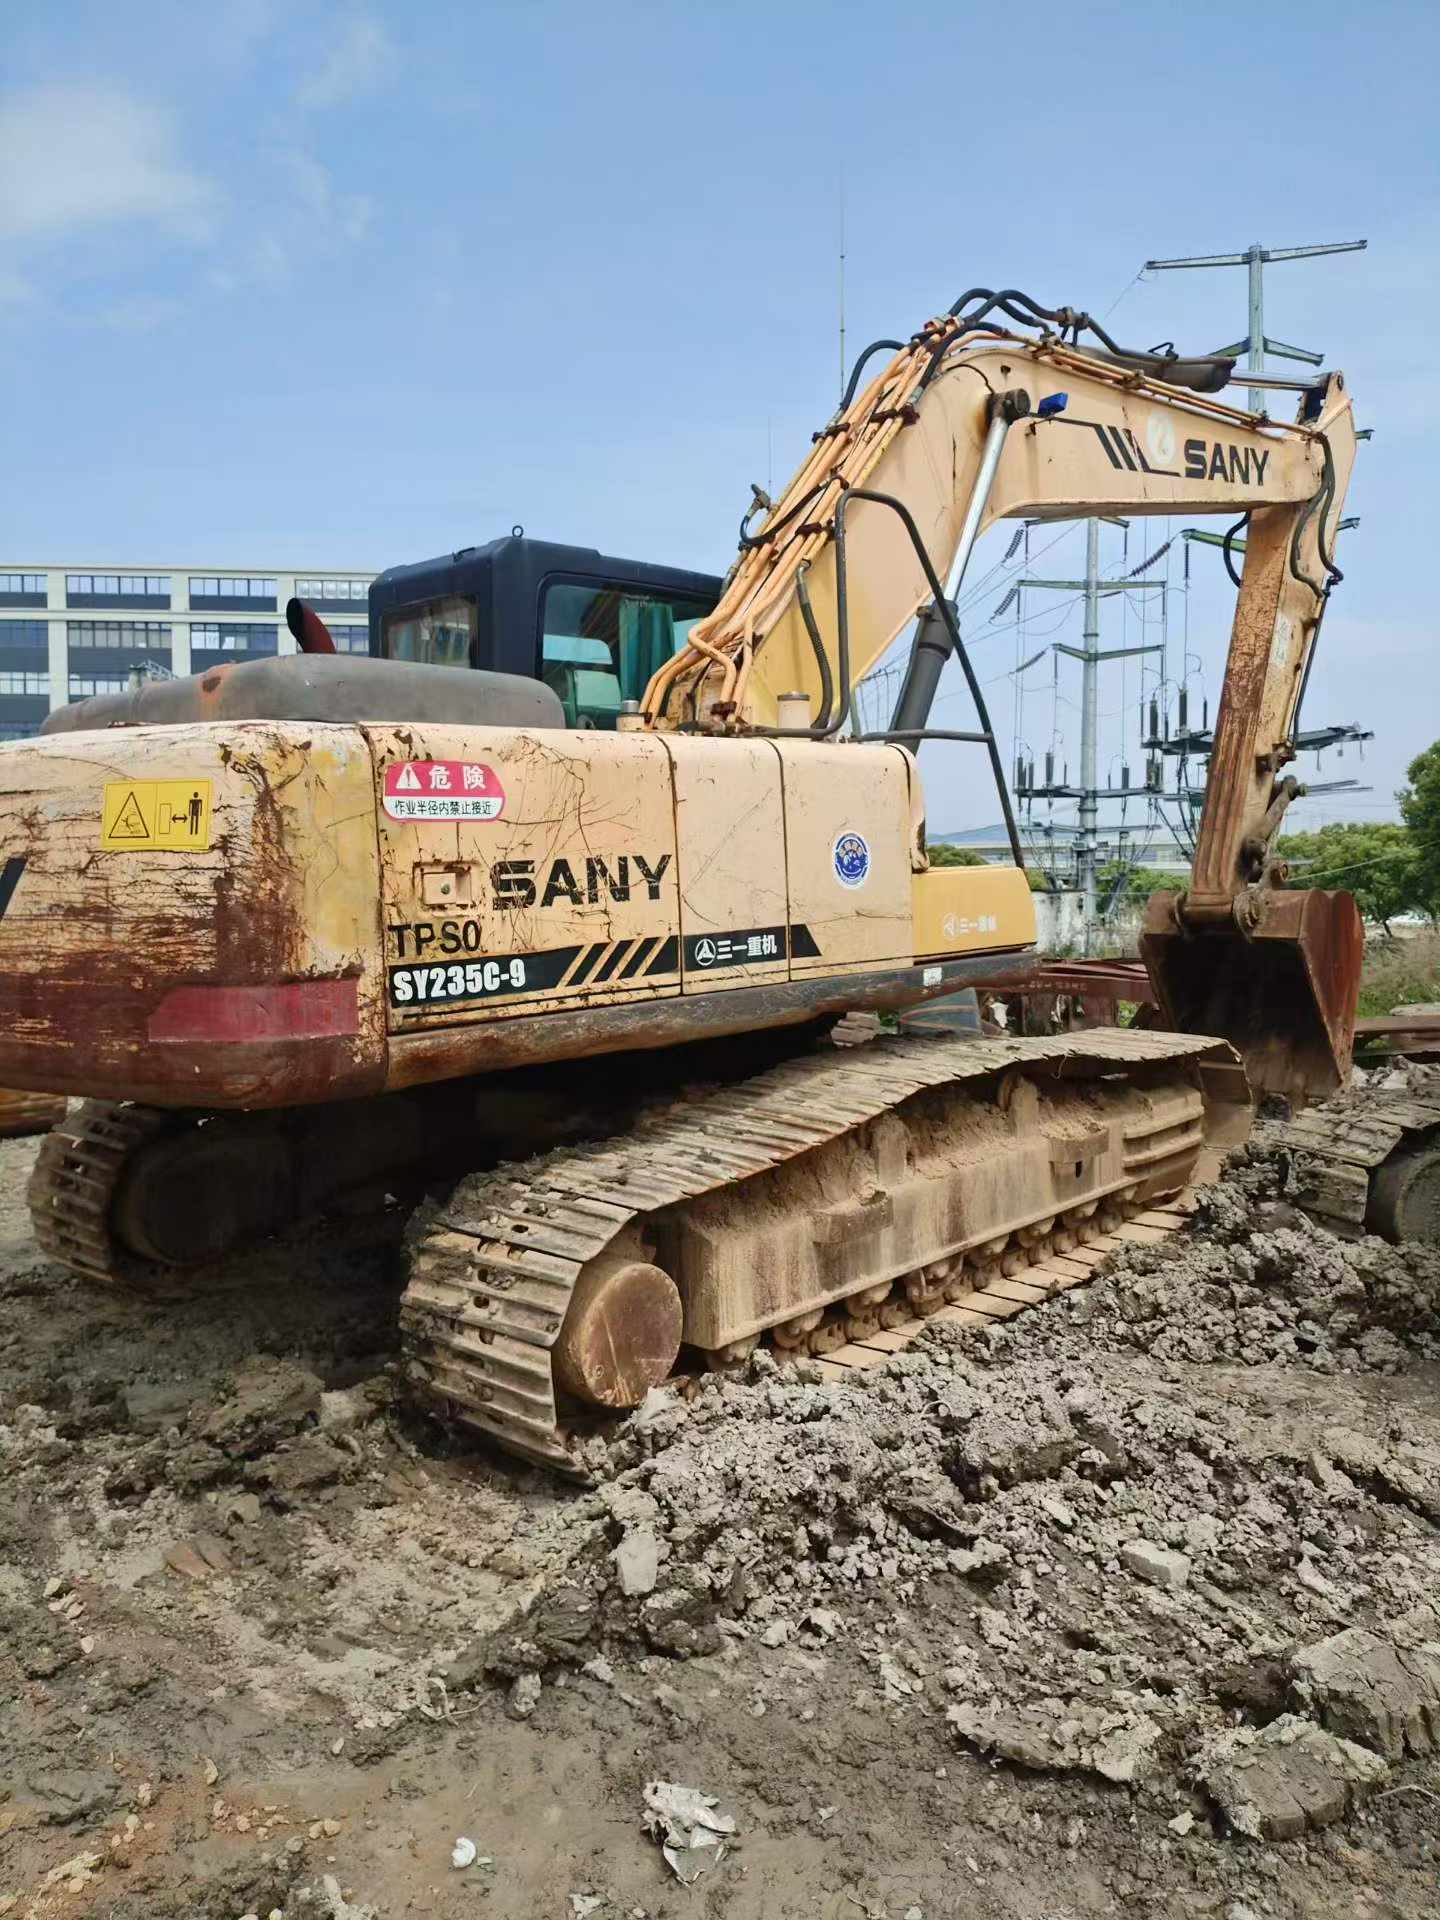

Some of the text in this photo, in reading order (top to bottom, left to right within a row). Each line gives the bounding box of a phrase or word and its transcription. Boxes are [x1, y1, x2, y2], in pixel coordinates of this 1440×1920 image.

[1184, 439, 1269, 486] SANY
[394, 800, 493, 816] 作业半径内禁止接近
[490, 854, 672, 911] SANY
[717, 934, 778, 960] 三一重机
[393, 958, 526, 1001] SY235C-9
